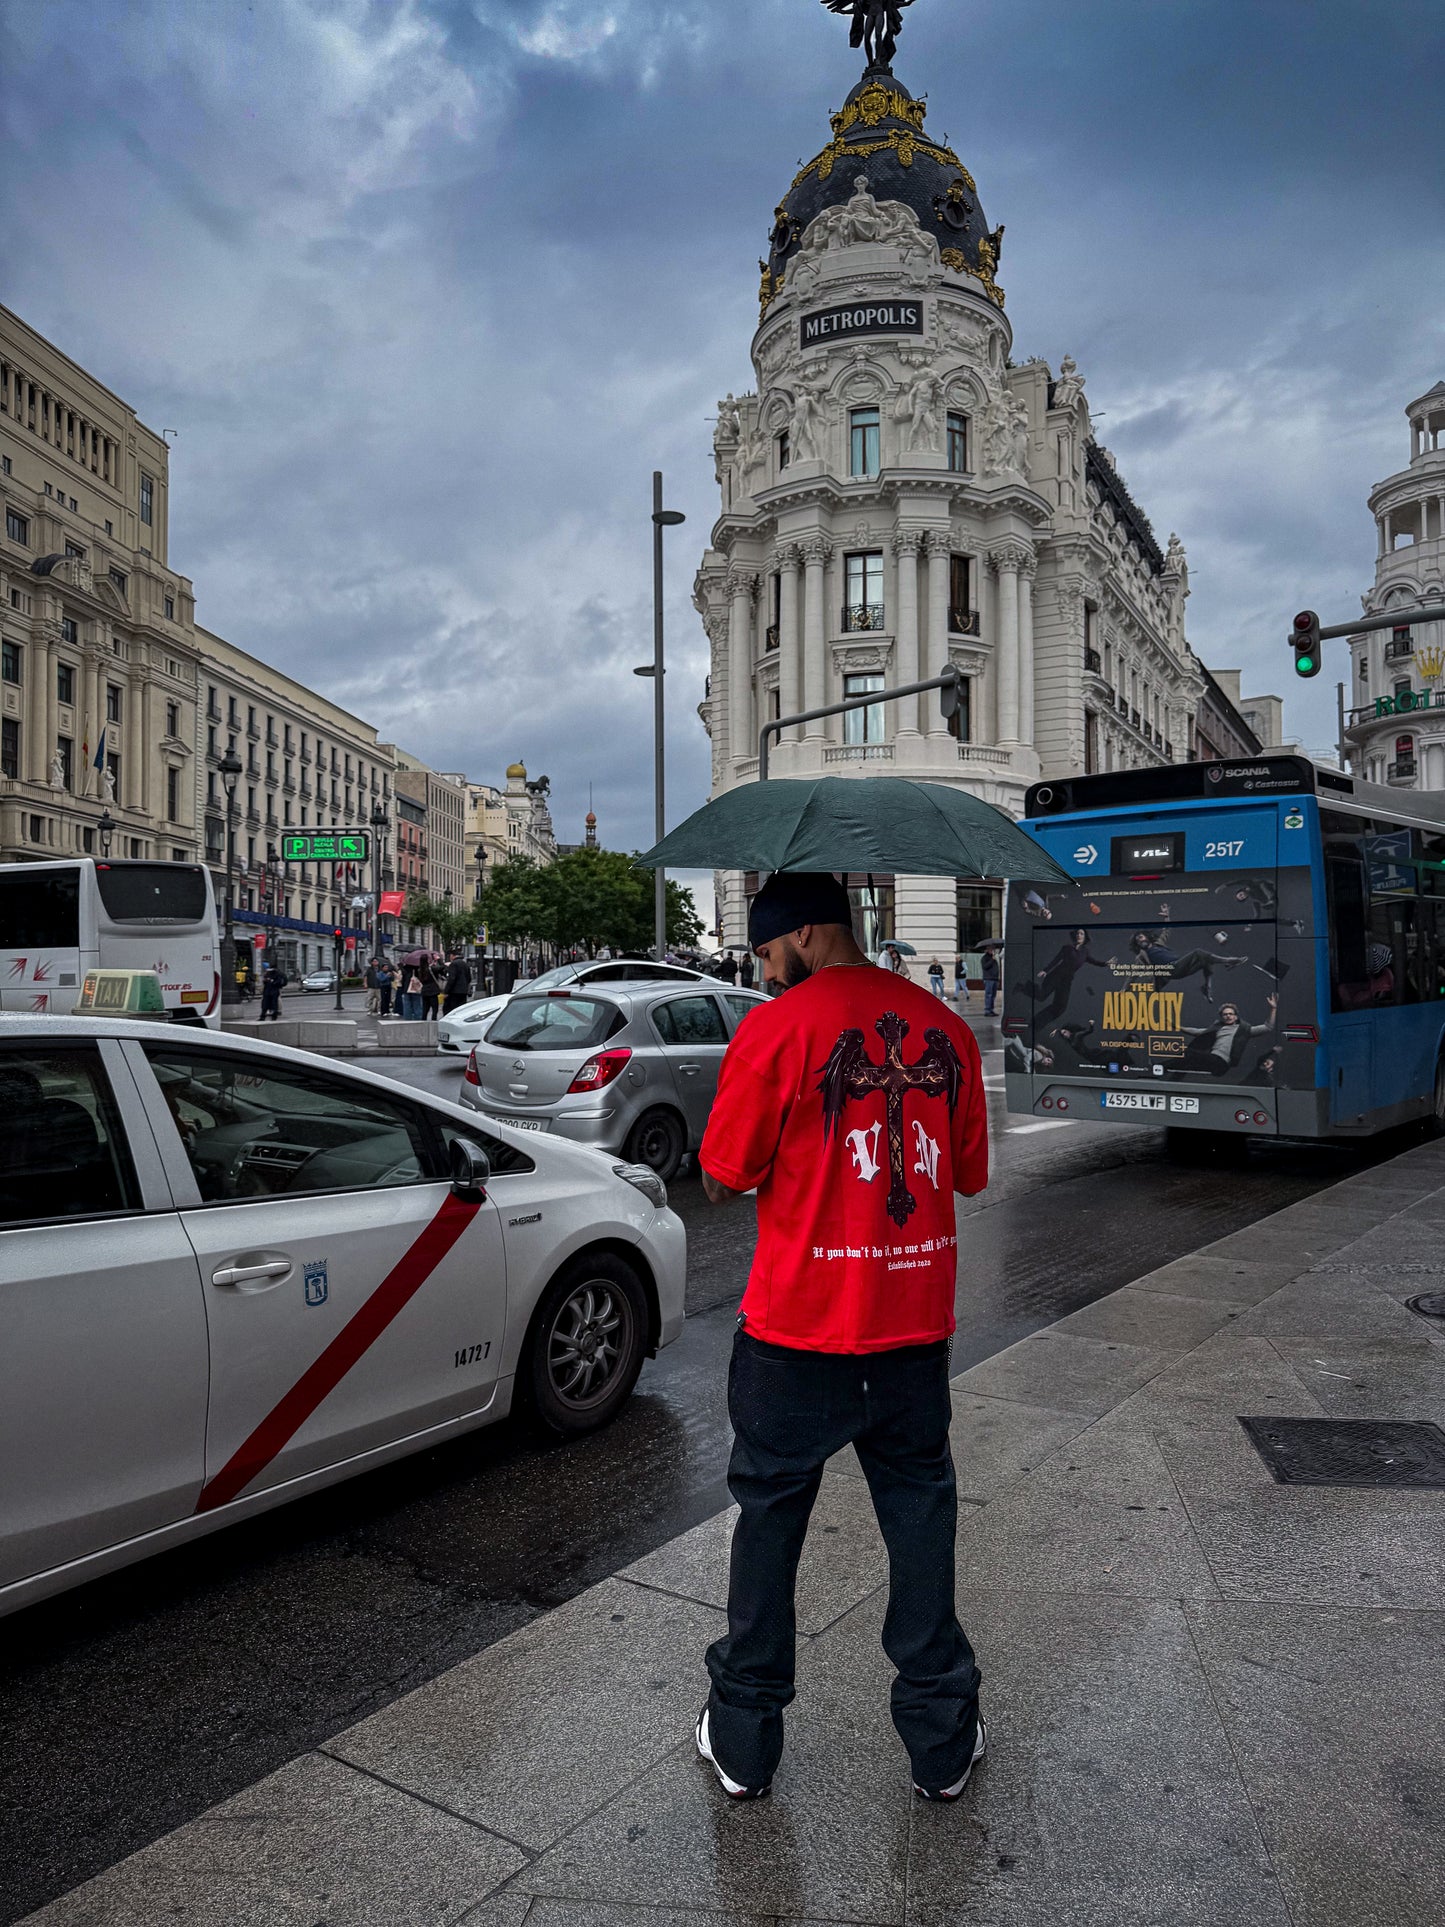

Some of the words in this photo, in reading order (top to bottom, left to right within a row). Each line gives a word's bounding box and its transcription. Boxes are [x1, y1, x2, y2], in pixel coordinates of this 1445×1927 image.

[805, 307, 917, 339] METROPOLIS
[1372, 687, 1442, 719] ROL
[1225, 766, 1271, 778] SCANIA
[1255, 779, 1300, 789] Castrosua
[293, 839, 304, 853] P
[1205, 840, 1244, 858] 2517
[98, 980, 127, 1005] TAXI
[1130, 983, 1154, 992] THE
[1102, 991, 1184, 1032] AUDACITY
[1100, 1040, 1109, 1048] YA
[1109, 1040, 1145, 1049] DISPONIBLE
[1108, 1094, 1137, 1107] 4575
[1174, 1098, 1195, 1111] SP
[812, 1246, 824, 1259] If
[827, 1248, 844, 1260] you
[845, 1245, 869, 1258] don't
[871, 1245, 883, 1258] do
[893, 1246, 902, 1255] no
[904, 1244, 919, 1254] one
[921, 1239, 934, 1252] will
[454, 1341, 491, 1368] 14727
